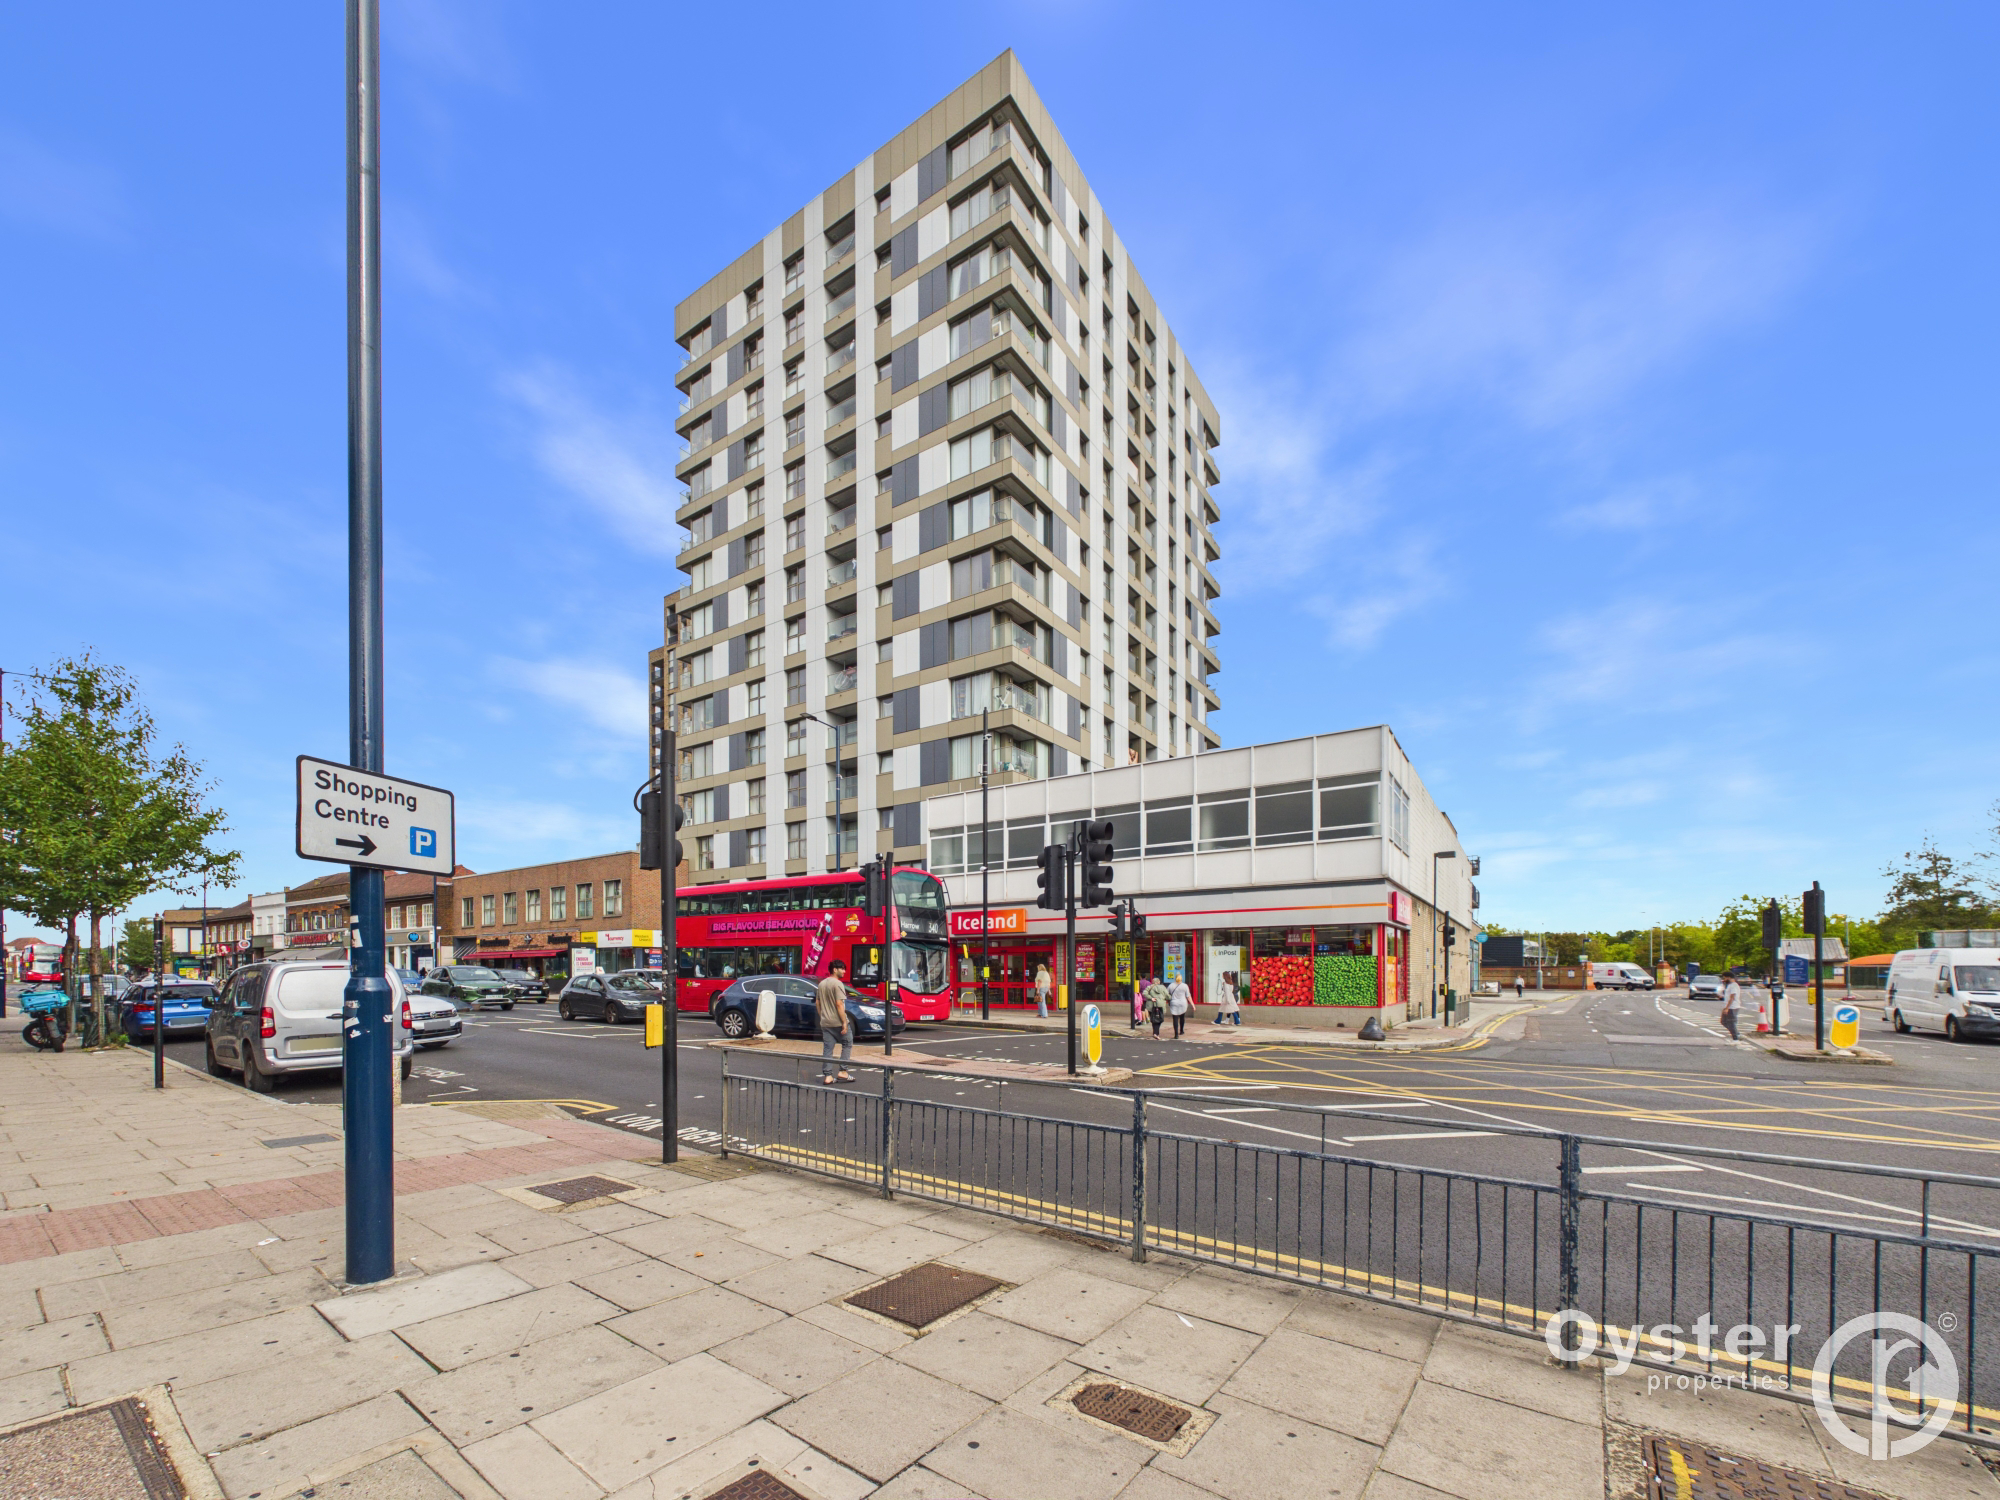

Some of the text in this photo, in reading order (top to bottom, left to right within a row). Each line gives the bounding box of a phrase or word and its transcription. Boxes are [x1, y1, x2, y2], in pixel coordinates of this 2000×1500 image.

[314, 769, 418, 812] Shopping
[314, 798, 390, 829] Centre
[415, 830, 433, 854] P
[712, 918, 818, 932] BIG FLAVOUR BEHAVIOUR
[900, 920, 939, 933] Harrow 340
